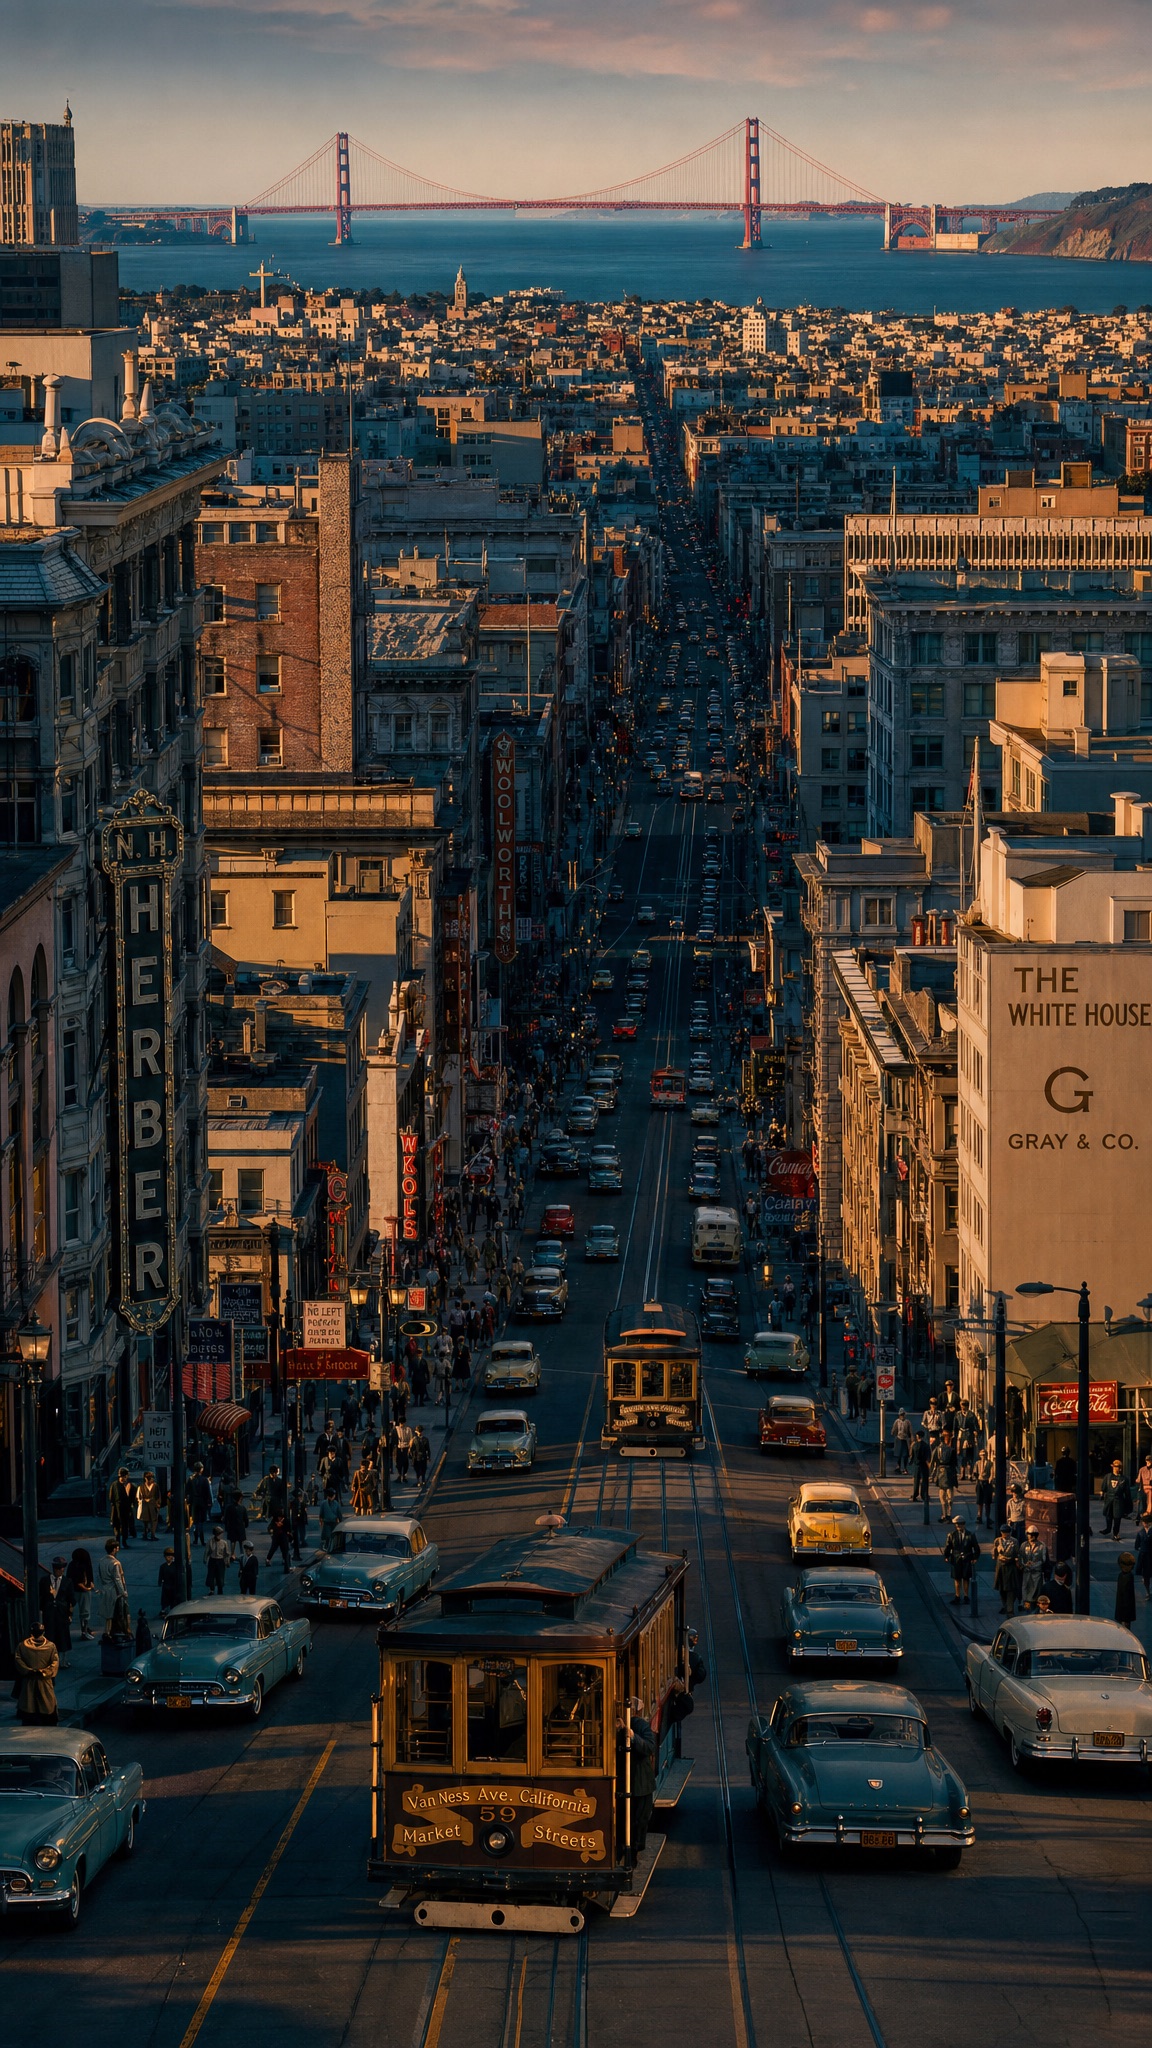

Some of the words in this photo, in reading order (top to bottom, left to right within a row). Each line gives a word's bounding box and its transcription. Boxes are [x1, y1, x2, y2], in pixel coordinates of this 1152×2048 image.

[1014, 966, 1079, 993] THE
[1008, 1003, 1077, 1027] WHITE
[1085, 1003, 1151, 1027] HOUSE
[129, 884, 165, 1292] HERBER
[1043, 1065, 1095, 1114] G
[1007, 1133, 1069, 1150] GRAY
[1077, 1133, 1091, 1150] &
[1101, 1133, 1139, 1150] CO.
[407, 1795, 436, 1810] Van
[439, 1789, 470, 1805] Ness
[477, 1787, 513, 1802] Ave.
[519, 1789, 591, 1815] California
[479, 1806, 517, 1823] 59
[403, 1824, 462, 1844] Market
[534, 1825, 597, 1849] Streets
